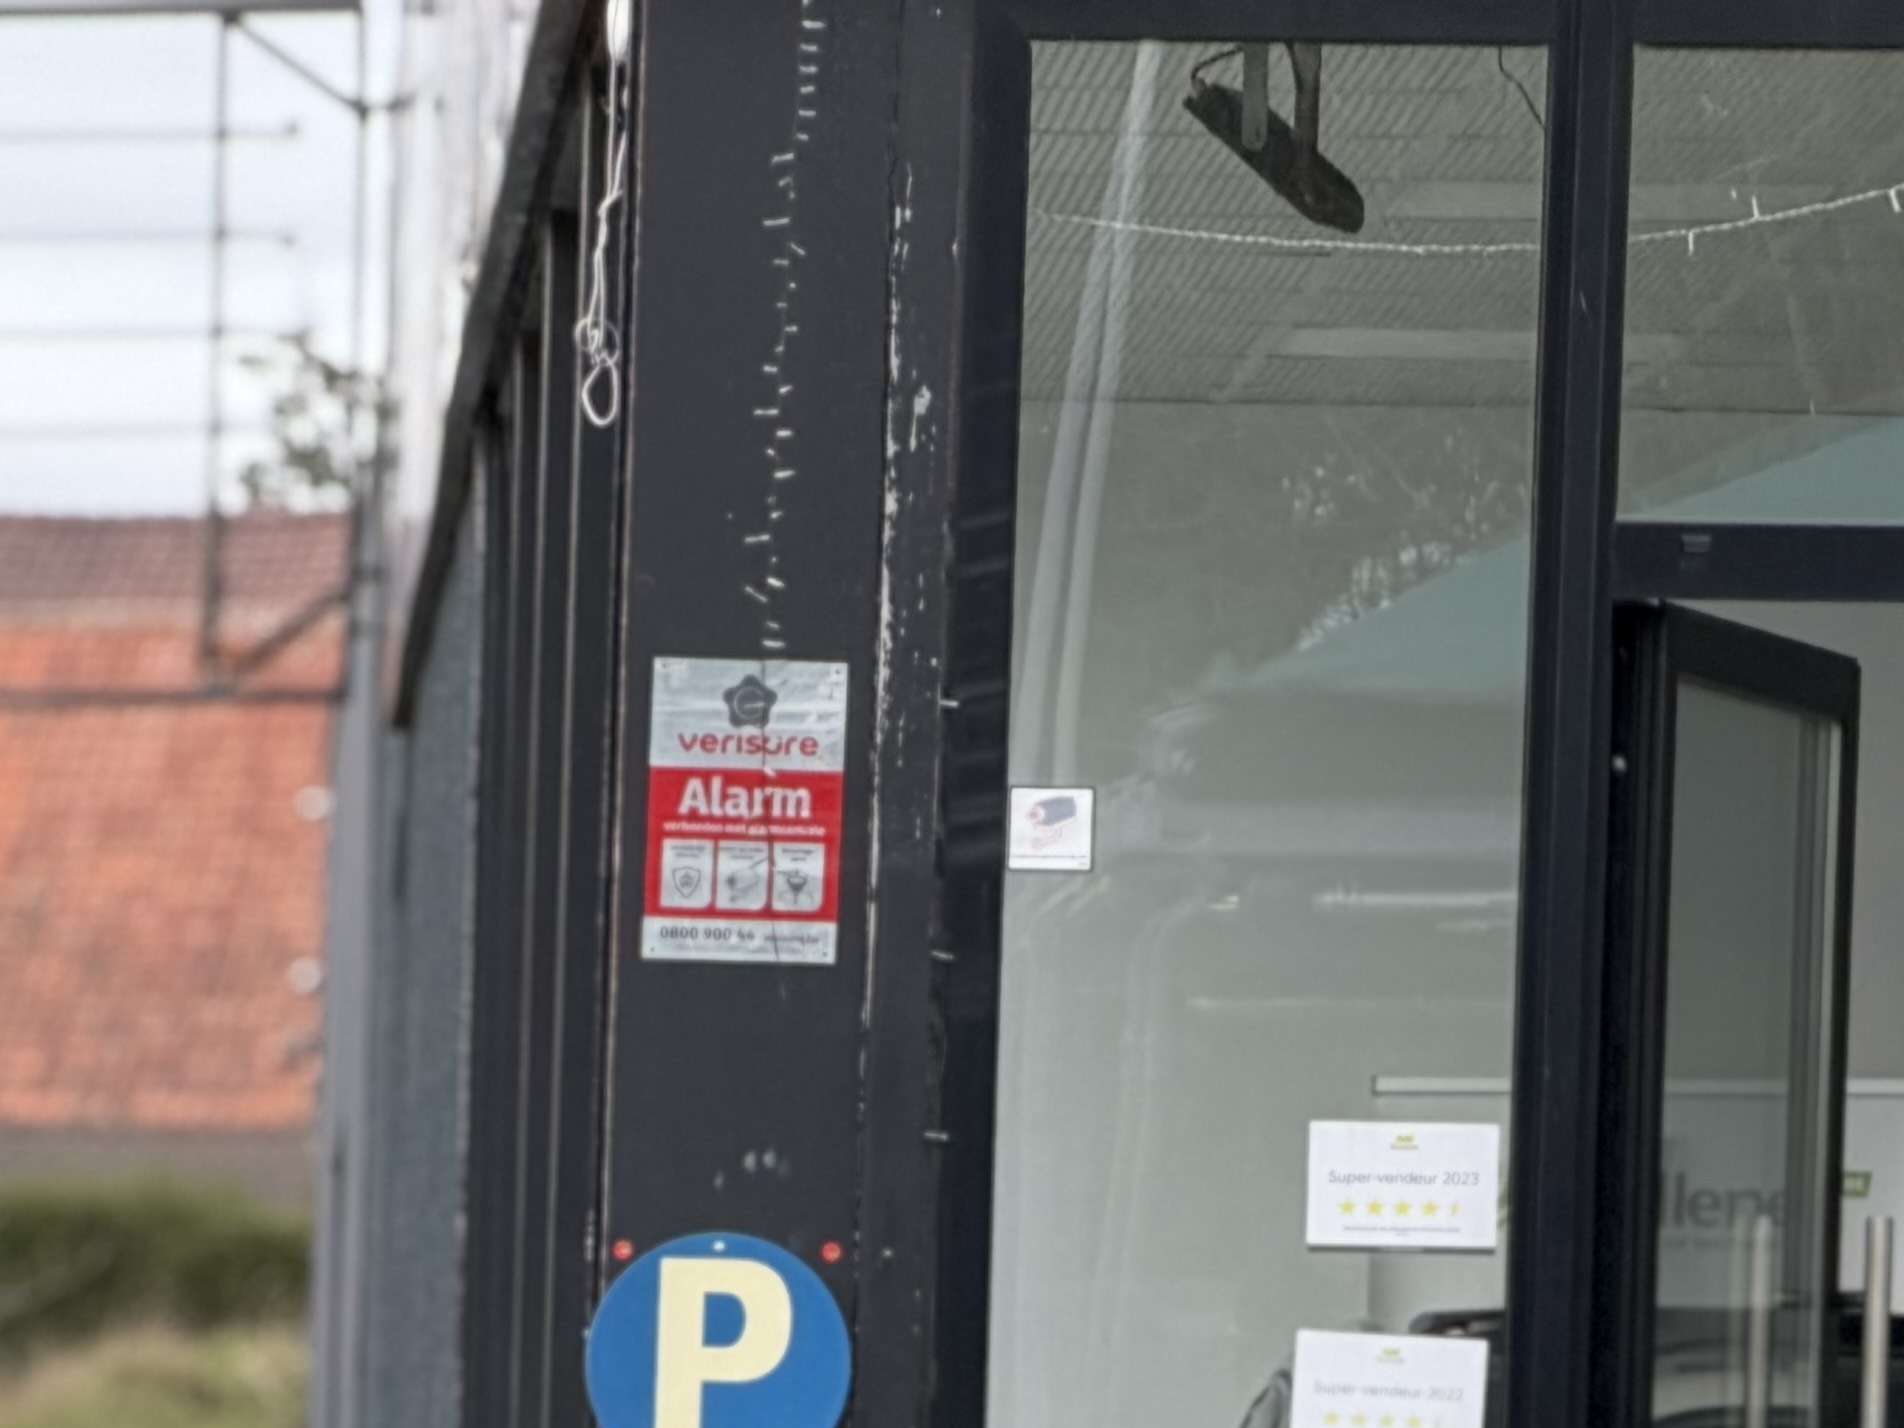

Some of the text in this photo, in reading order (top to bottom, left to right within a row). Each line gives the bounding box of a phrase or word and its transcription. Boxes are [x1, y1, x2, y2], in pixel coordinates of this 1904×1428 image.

[678, 732, 819, 757] verisure
[678, 776, 812, 819] Alarm
[659, 925, 698, 940] 0800
[1443, 1171, 1480, 1186] 2023
